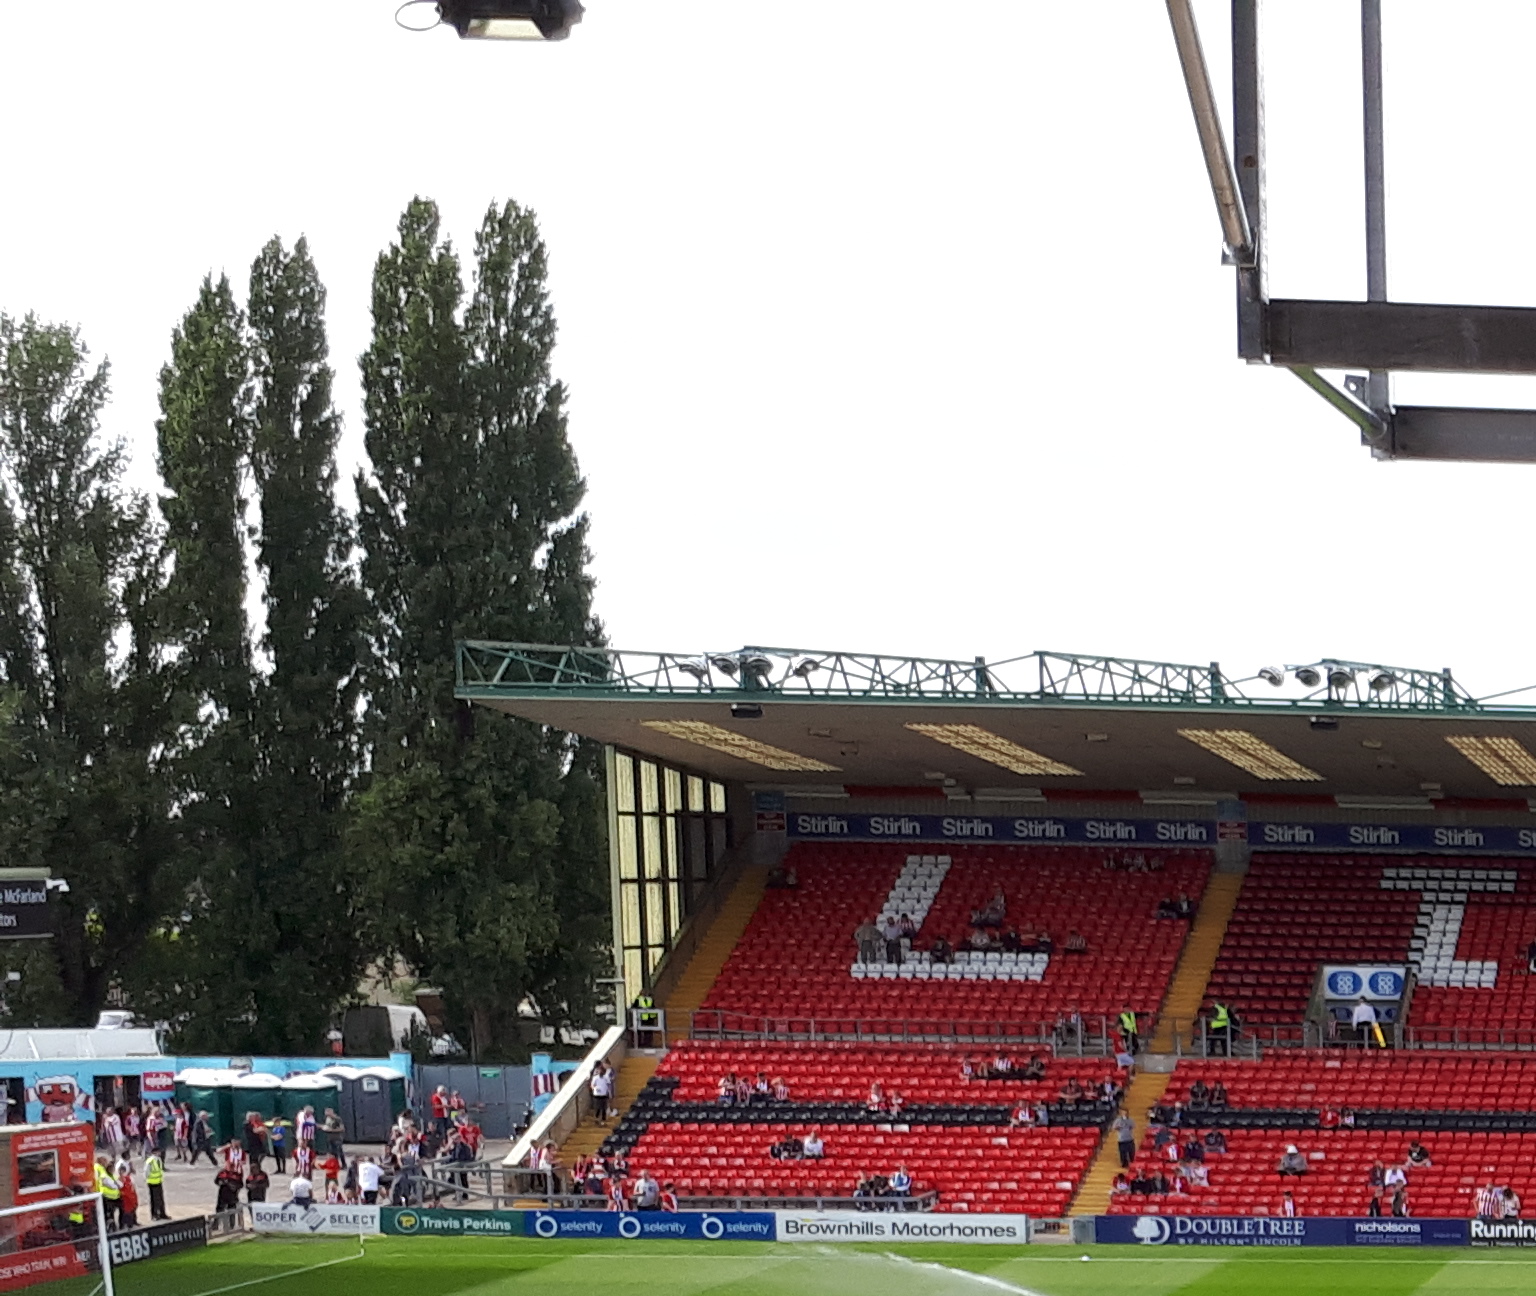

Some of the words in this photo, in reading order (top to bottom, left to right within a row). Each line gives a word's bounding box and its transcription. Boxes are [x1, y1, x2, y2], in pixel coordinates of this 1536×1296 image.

[797, 815, 848, 836] Stirlin
[869, 816, 921, 837] Stirlin
[942, 817, 993, 838] Stirlin
[1014, 818, 1065, 839] Stirlin
[1086, 819, 1136, 840] Stirlin
[1156, 821, 1207, 841] Stirlin
[1264, 824, 1315, 844] Stirlin
[1349, 825, 1400, 845] Stirlin
[1434, 827, 1484, 847] Stirlin
[255, 1212, 297, 1223] SOPER
[329, 1213, 377, 1225] SELECT
[421, 1216, 461, 1229] Travis
[463, 1216, 512, 1231] Perkins
[560, 1221, 603, 1234] selenity
[643, 1221, 687, 1234] selenity
[726, 1222, 770, 1235] selenity
[785, 1219, 886, 1236] Brownhills
[891, 1221, 1018, 1238] Motorhomes
[1354, 1221, 1421, 1234] nicholsons
[99, 1231, 151, 1266] EBBS
